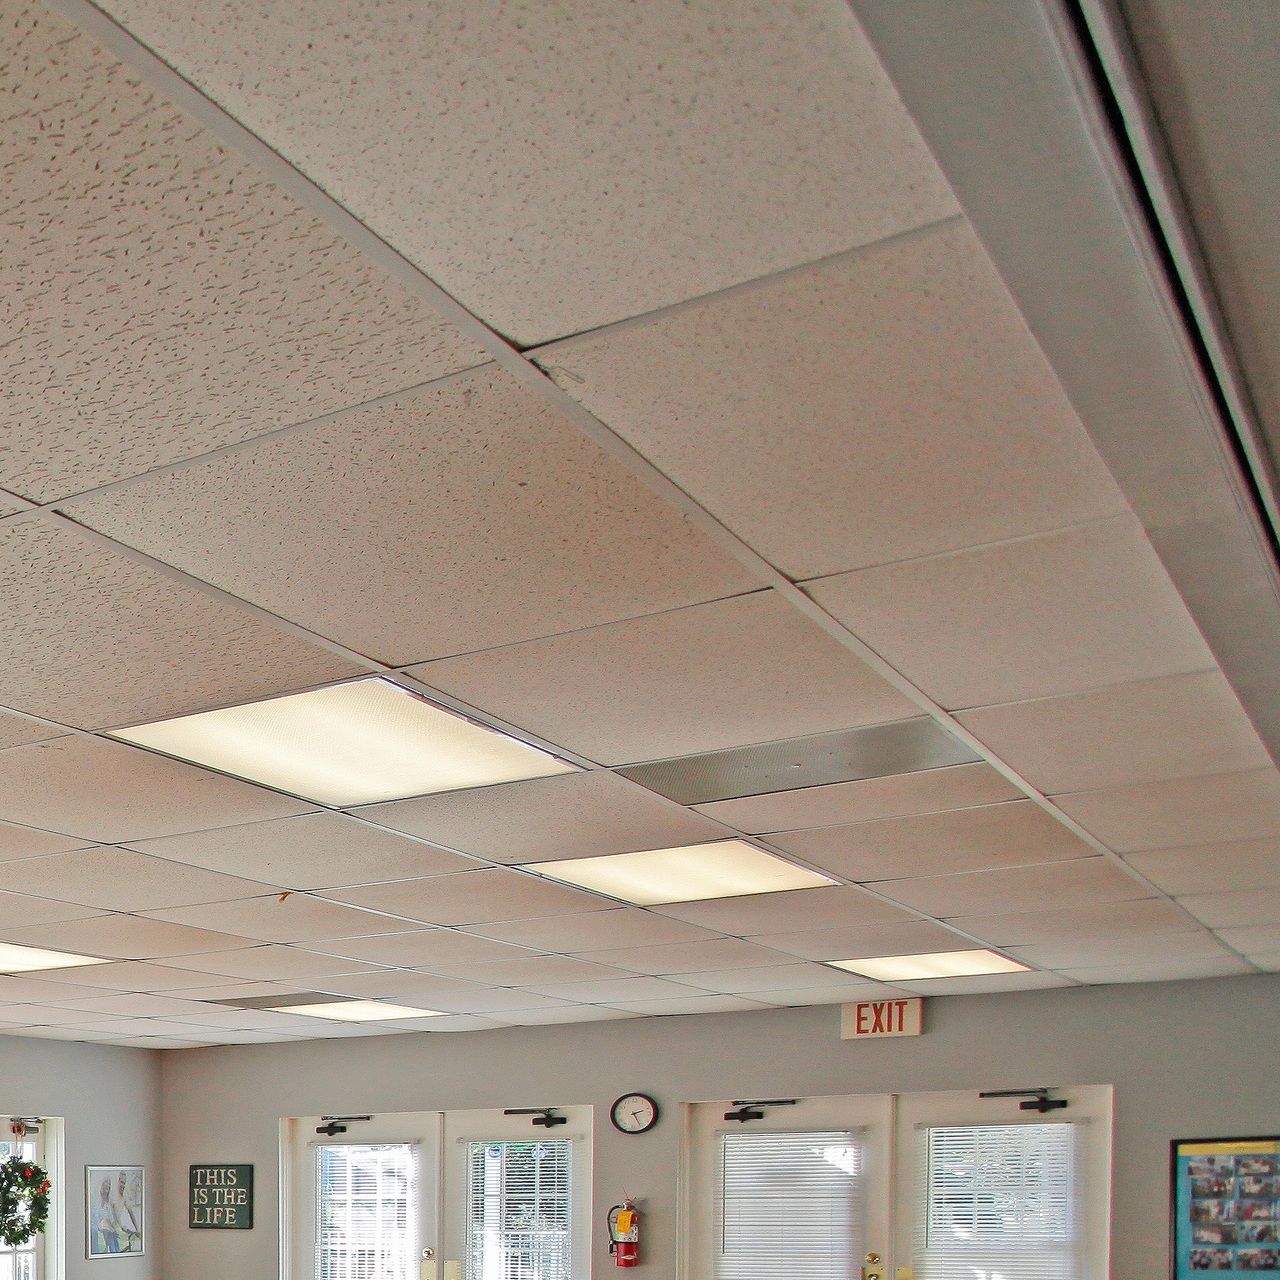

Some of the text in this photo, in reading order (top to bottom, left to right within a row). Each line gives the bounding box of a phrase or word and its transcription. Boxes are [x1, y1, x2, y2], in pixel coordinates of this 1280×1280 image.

[856, 1001, 908, 1034] EXIT
[193, 1168, 237, 1186] THIS
[193, 1188, 248, 1205] IS THE
[193, 1207, 237, 1225] LIFE
